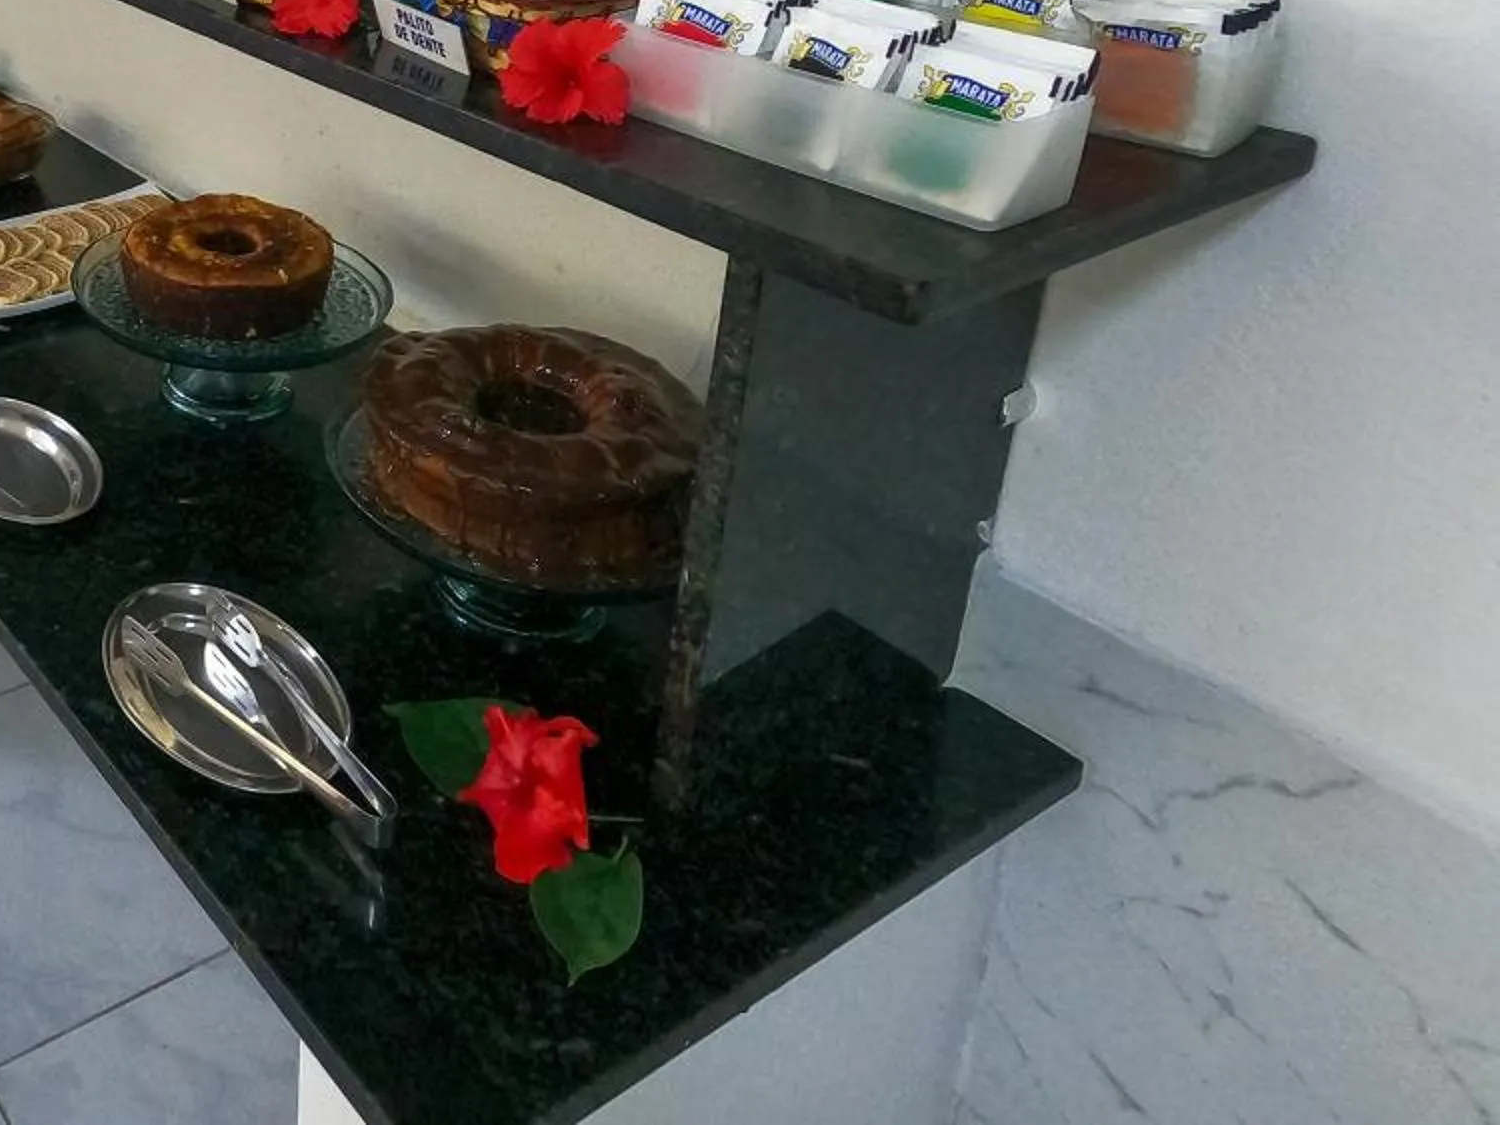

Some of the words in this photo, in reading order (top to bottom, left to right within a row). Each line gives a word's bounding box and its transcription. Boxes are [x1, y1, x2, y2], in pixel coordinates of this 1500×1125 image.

[395, 8, 435, 36] PALITO
[394, 22, 410, 42] DE
[411, 30, 447, 58] DENTE
